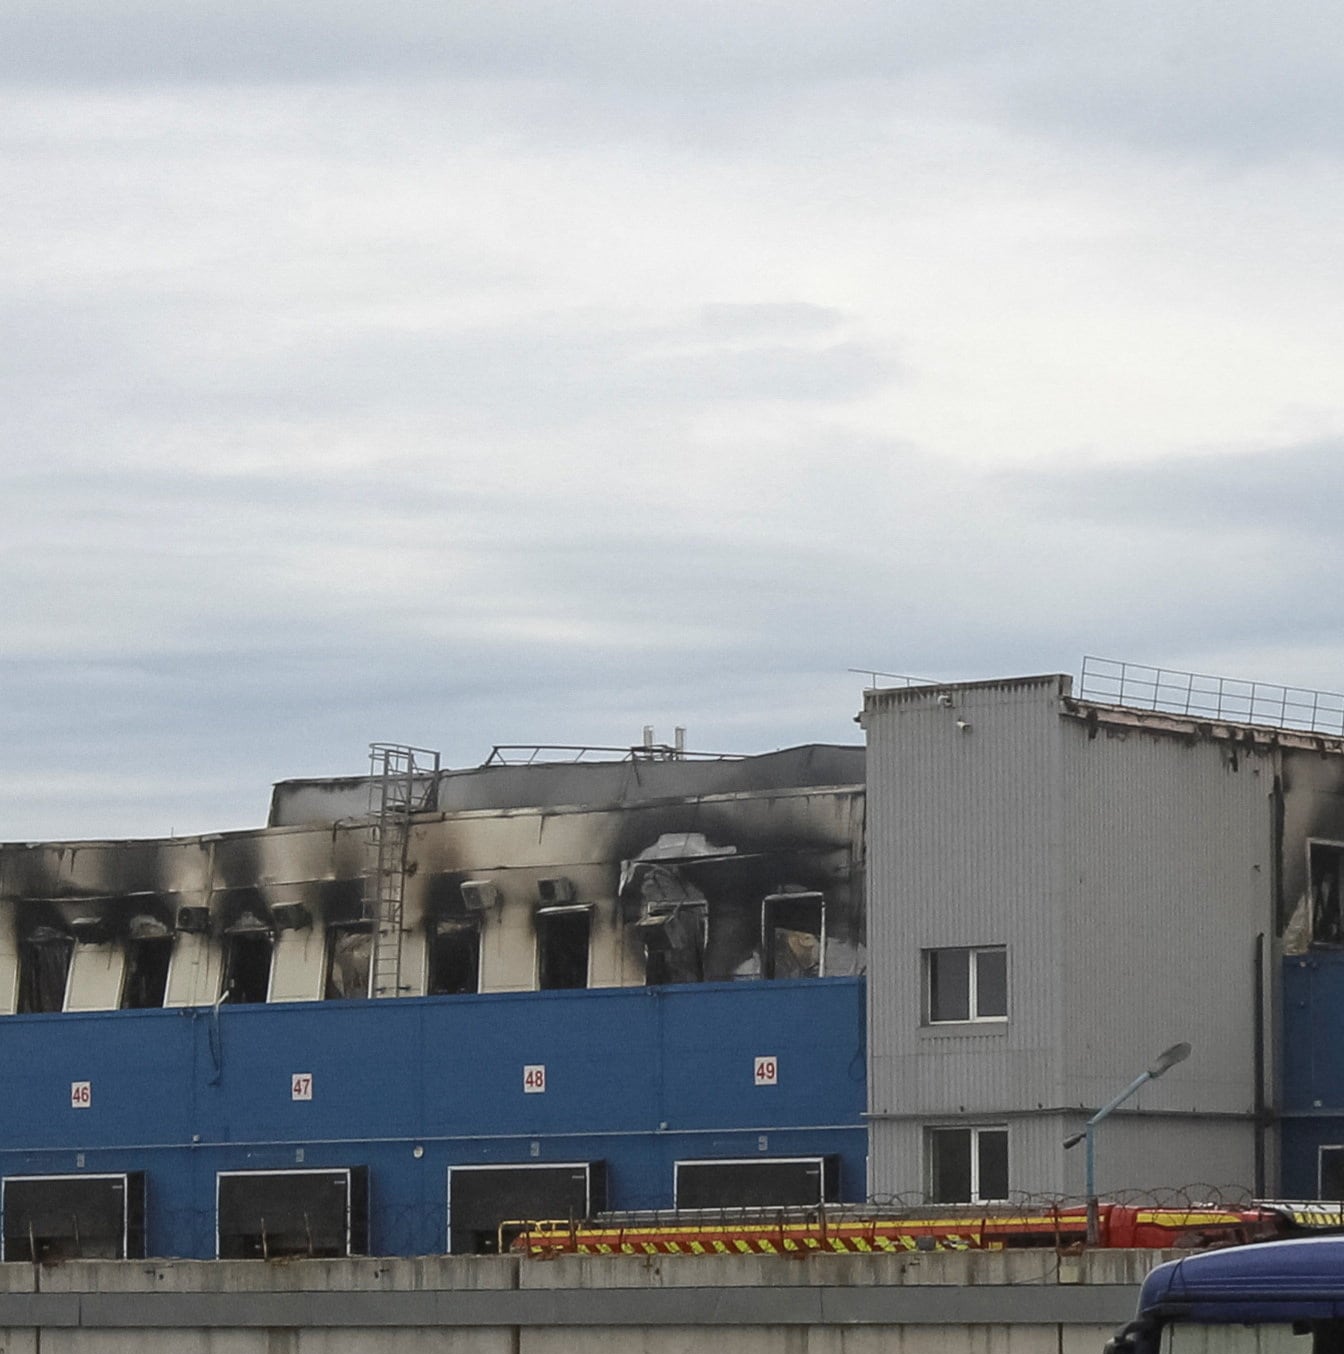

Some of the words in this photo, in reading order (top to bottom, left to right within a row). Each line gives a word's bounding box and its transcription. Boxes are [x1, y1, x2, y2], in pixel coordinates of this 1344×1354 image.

[756, 1062, 775, 1079] 49
[526, 1071, 543, 1087] 48
[73, 1087, 89, 1103] 46
[293, 1079, 311, 1096] 47
